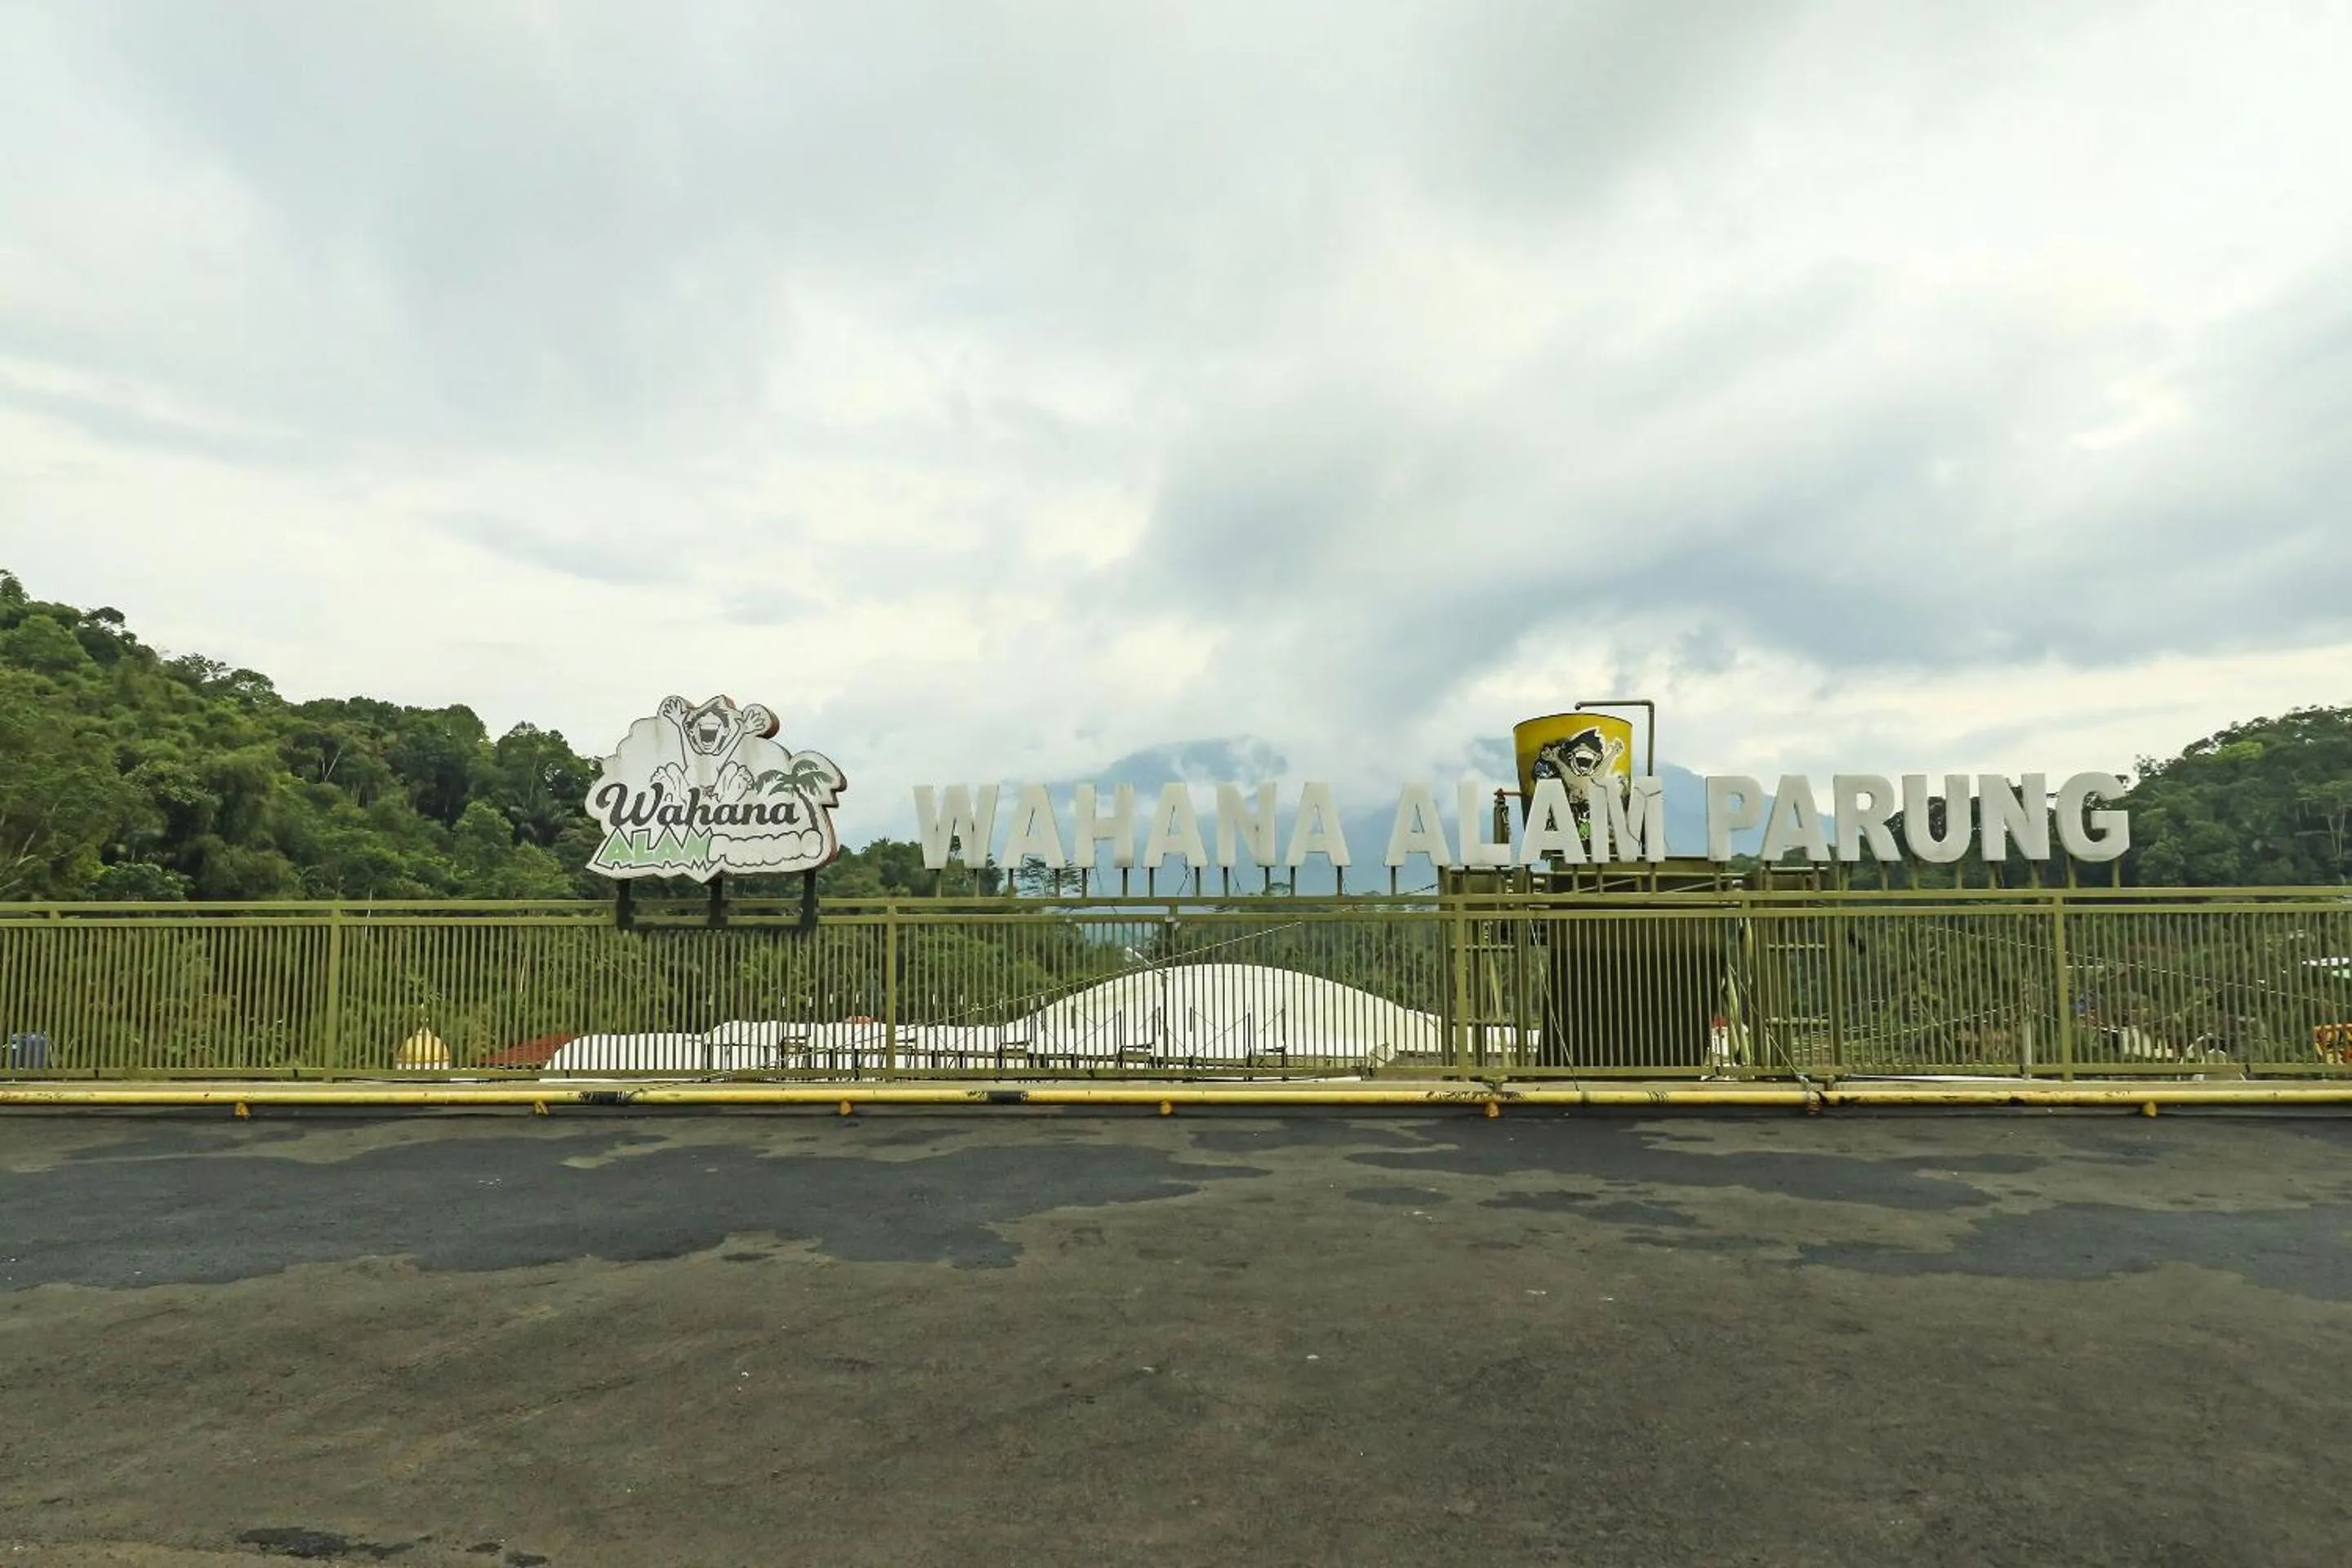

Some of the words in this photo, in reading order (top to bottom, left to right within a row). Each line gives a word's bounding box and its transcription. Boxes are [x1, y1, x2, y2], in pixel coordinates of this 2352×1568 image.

[595, 782, 800, 827] Wahana
[912, 782, 1352, 870] WAHANA
[1384, 775, 1665, 866] ALAM
[1705, 771, 2131, 863] PARUNG
[595, 827, 712, 869] ALAM
